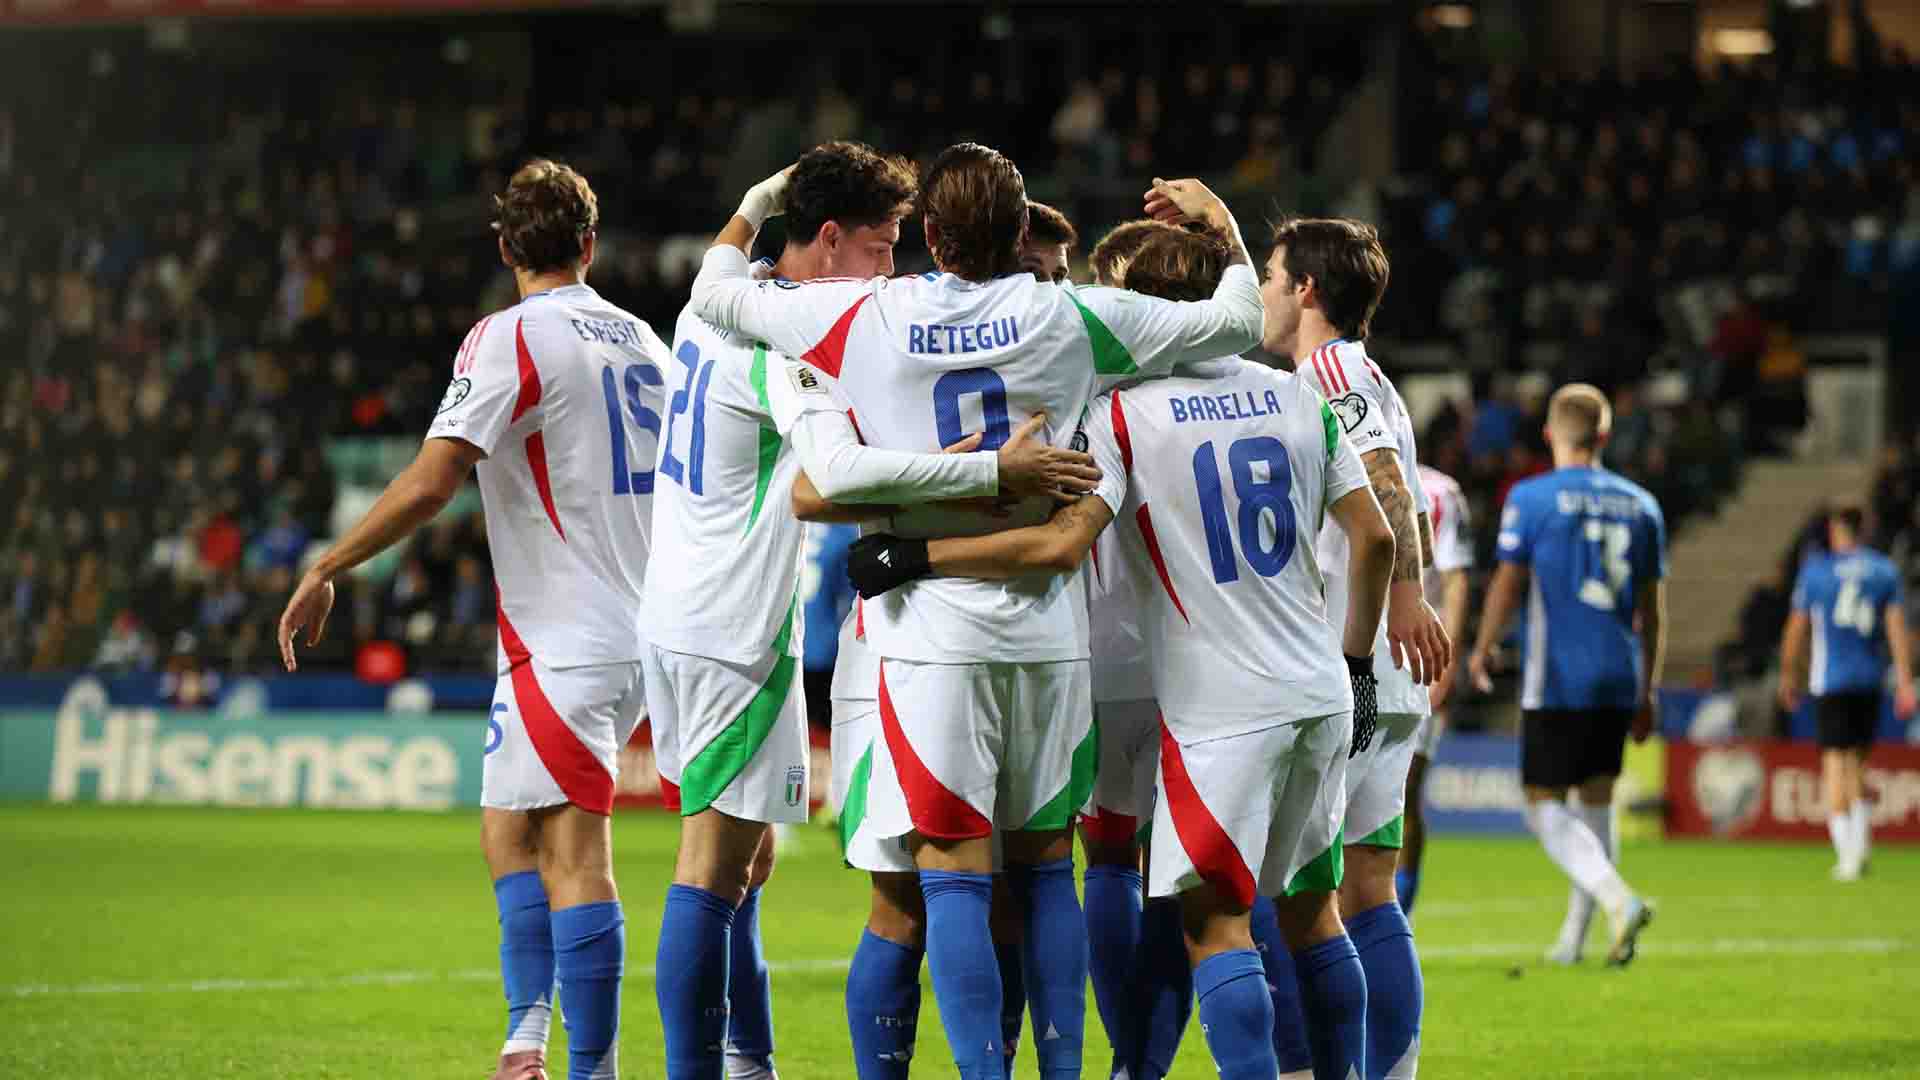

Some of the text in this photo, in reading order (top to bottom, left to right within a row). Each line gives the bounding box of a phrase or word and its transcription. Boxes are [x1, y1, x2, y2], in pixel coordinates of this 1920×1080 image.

[908, 316, 1019, 354] RETEGUI
[659, 339, 716, 496] 21
[1169, 390, 1281, 422] BARELLA
[1193, 436, 1297, 584] 18
[1576, 519, 1632, 611] 3
[1835, 575, 1873, 638] 4
[50, 703, 459, 810] Hisense
